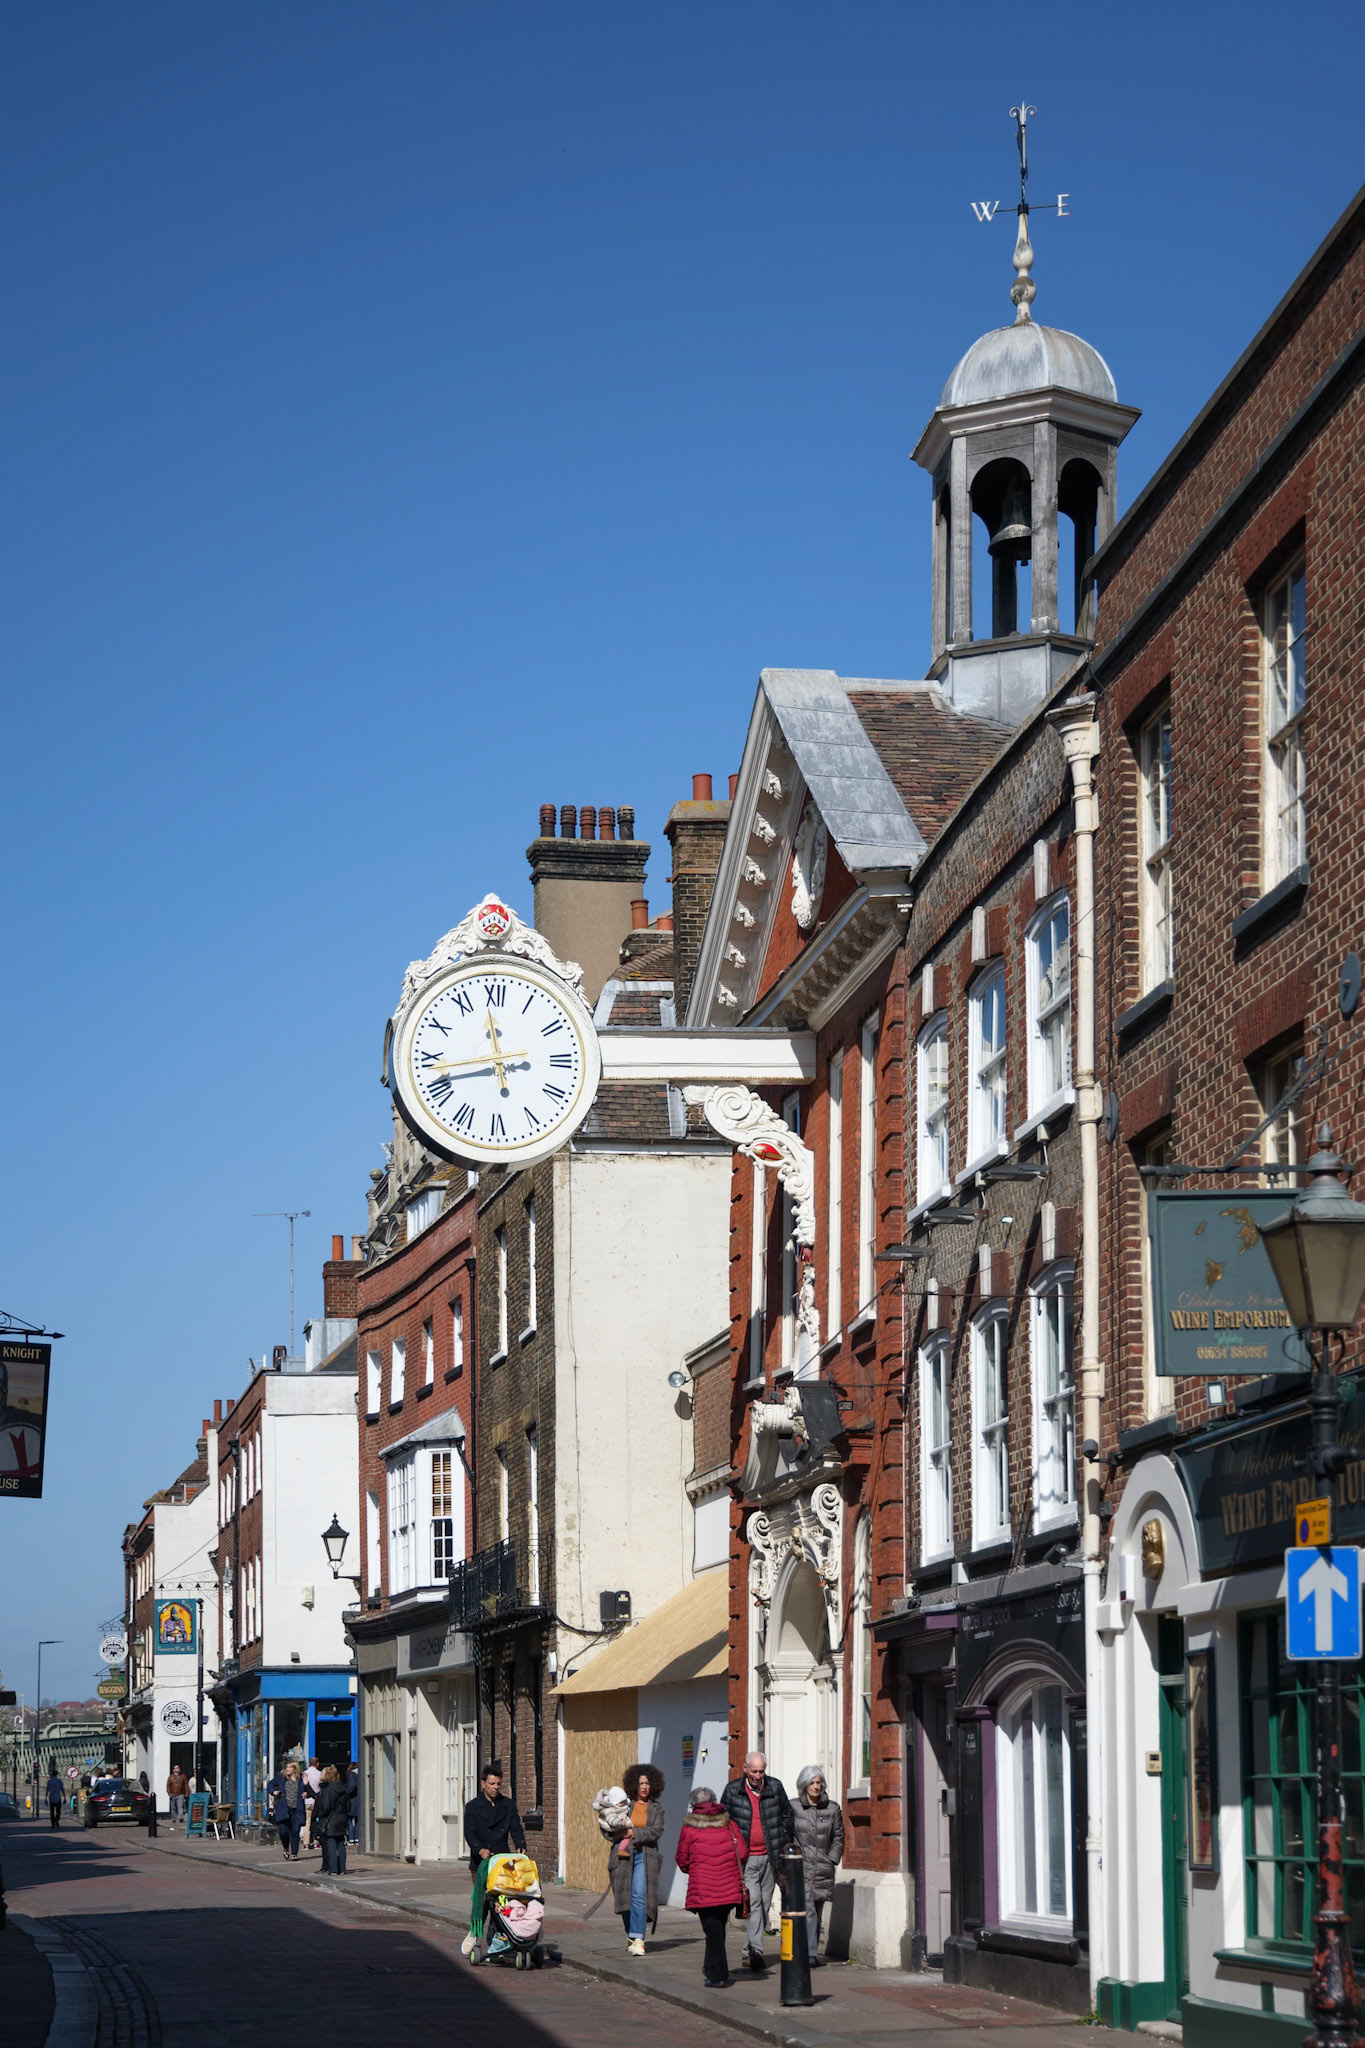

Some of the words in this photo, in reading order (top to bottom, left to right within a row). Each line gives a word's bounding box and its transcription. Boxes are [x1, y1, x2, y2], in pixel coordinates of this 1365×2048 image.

[970, 200, 1000, 223] W
[1056, 193, 1071, 217] E
[451, 990, 474, 1017] XI
[484, 984, 507, 1008] XII
[521, 994, 535, 1015] I
[428, 1017, 452, 1037] X
[541, 1019, 563, 1037] II
[549, 1053, 572, 1069] III
[427, 1078, 455, 1108] VIII
[542, 1082, 566, 1105] IV
[452, 1102, 475, 1130] VII
[490, 1113, 507, 1136] VI
[523, 1106, 540, 1128] V
[1170, 1309, 1210, 1330] WINE
[2, 1346, 42, 1360] KNIGHT
[1220, 1487, 1267, 1537] WINE
[98, 1685, 125, 1694] BAGGINS
